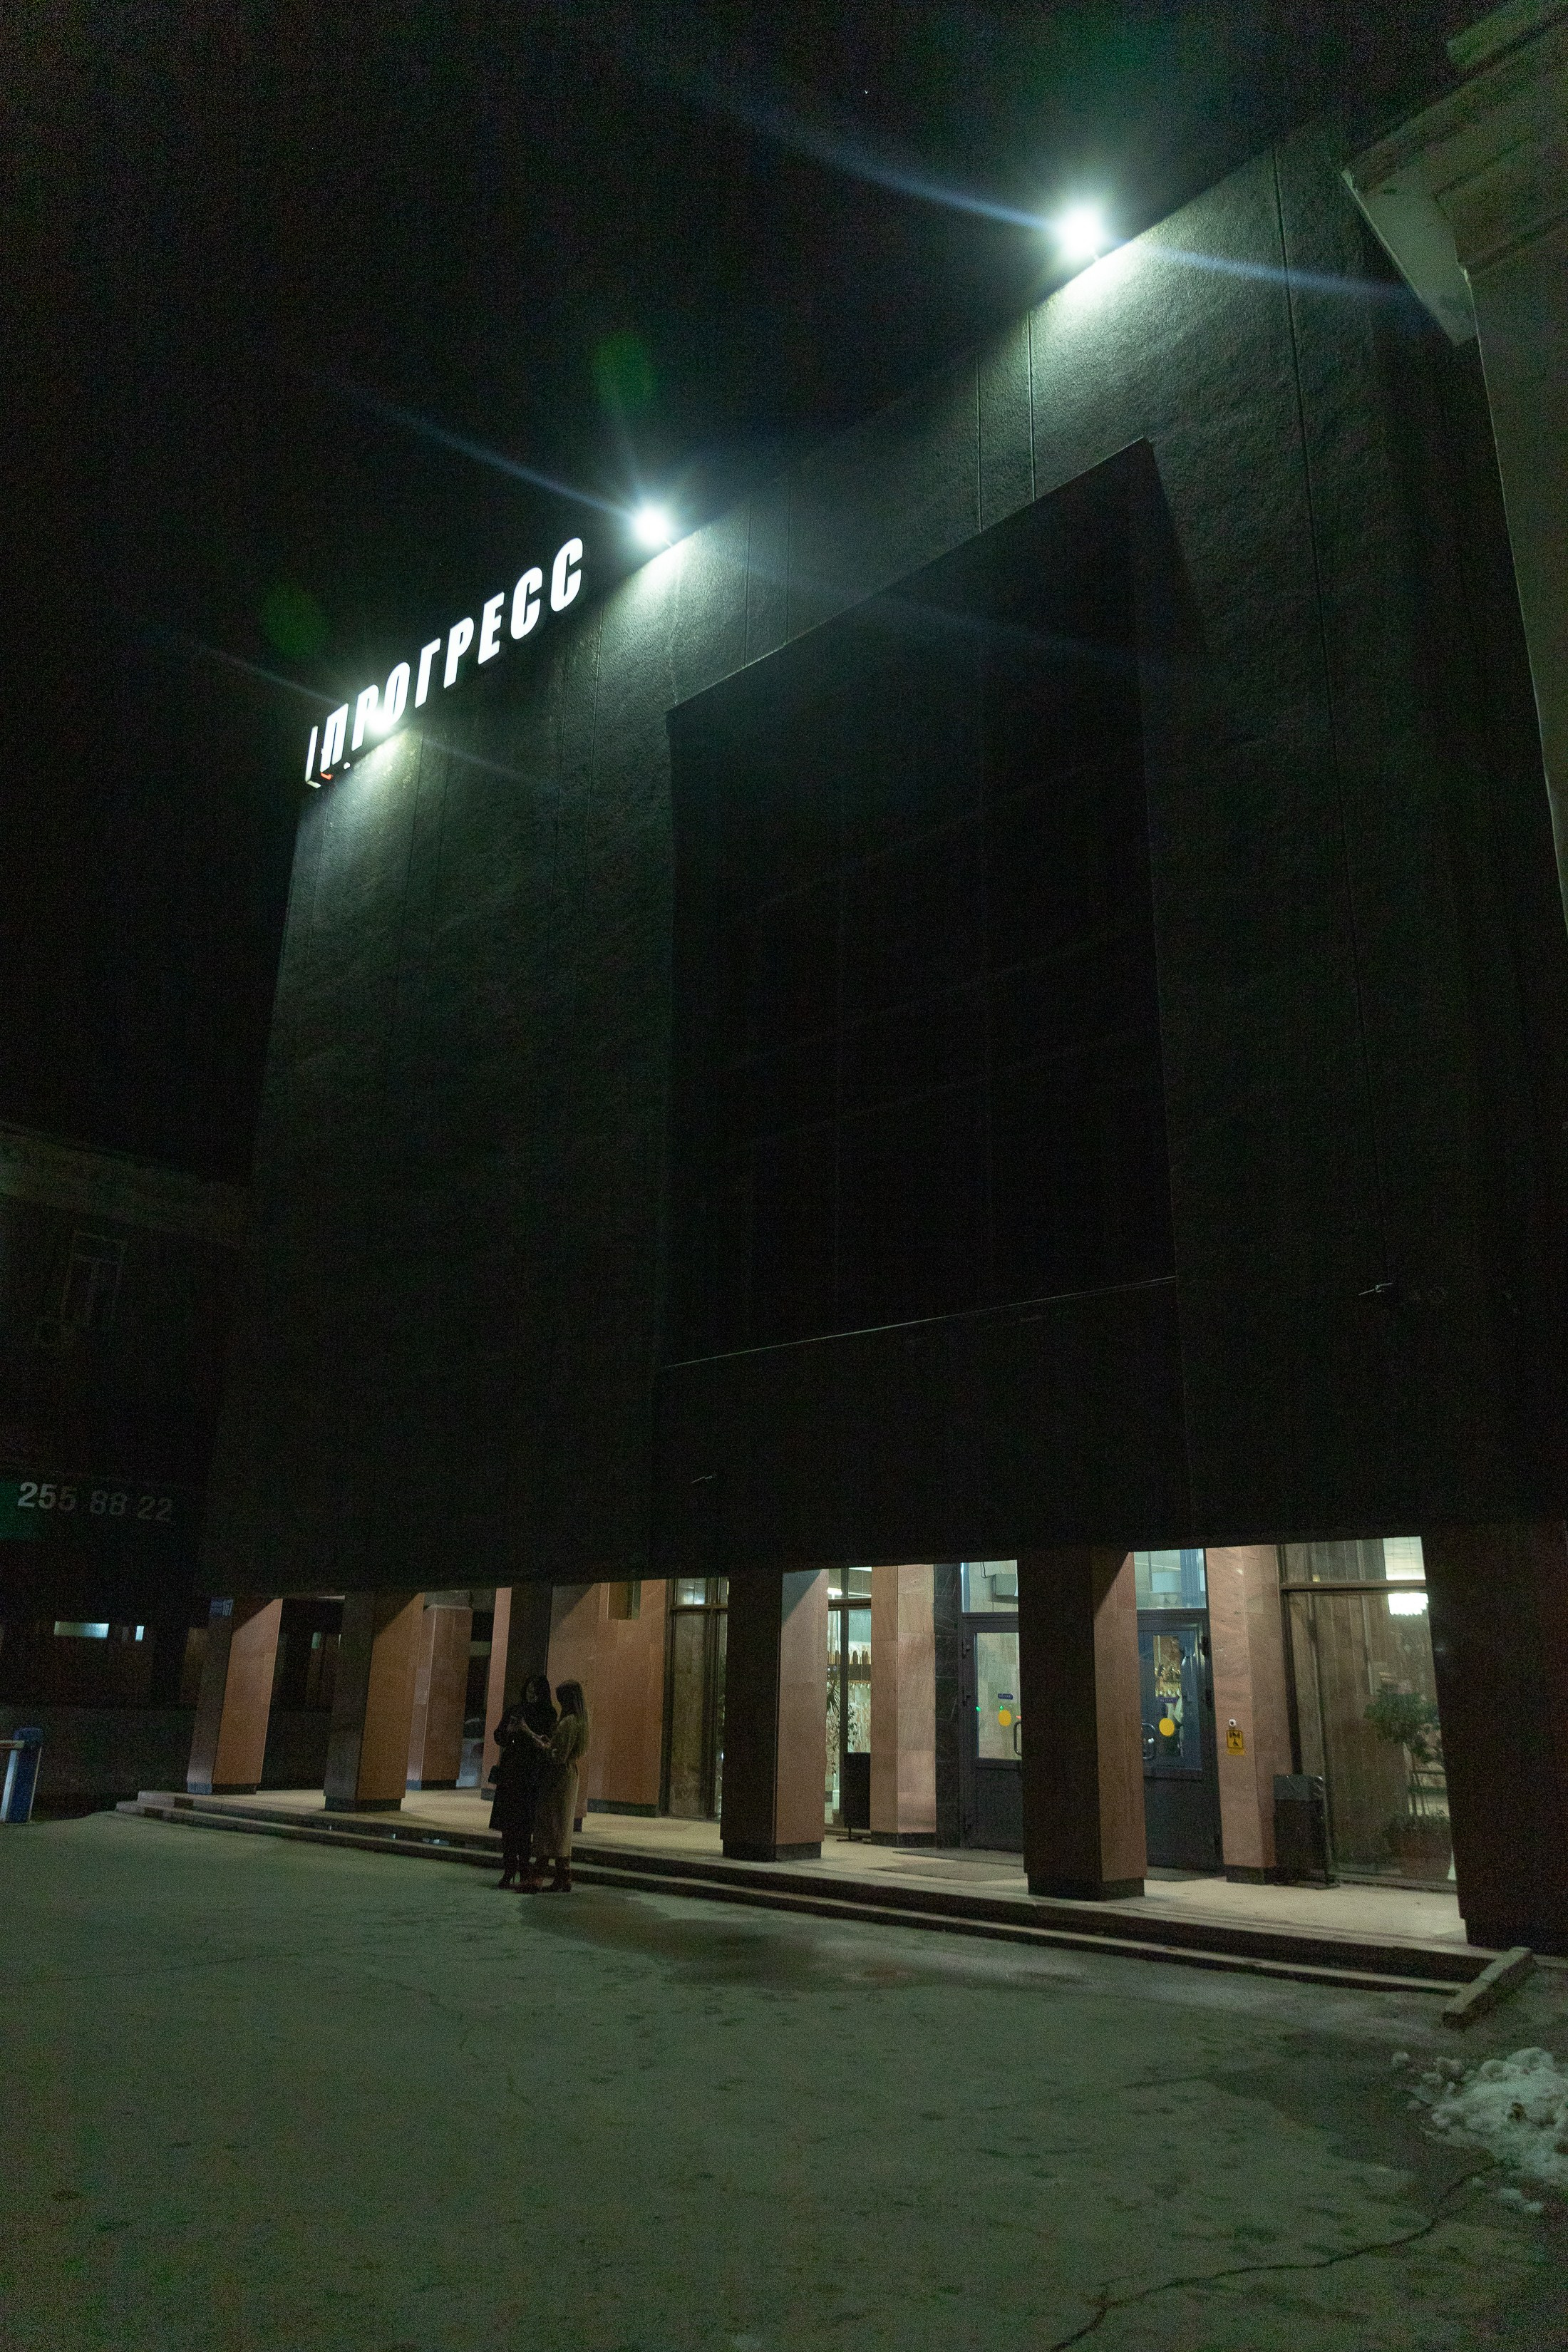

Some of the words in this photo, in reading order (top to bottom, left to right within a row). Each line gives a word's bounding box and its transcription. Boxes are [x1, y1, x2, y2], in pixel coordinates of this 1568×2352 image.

[320, 537, 583, 773] ПРОГРЕСС
[17, 1481, 76, 1512] 255
[90, 1490, 128, 1516] 88
[137, 1497, 172, 1523] 22
